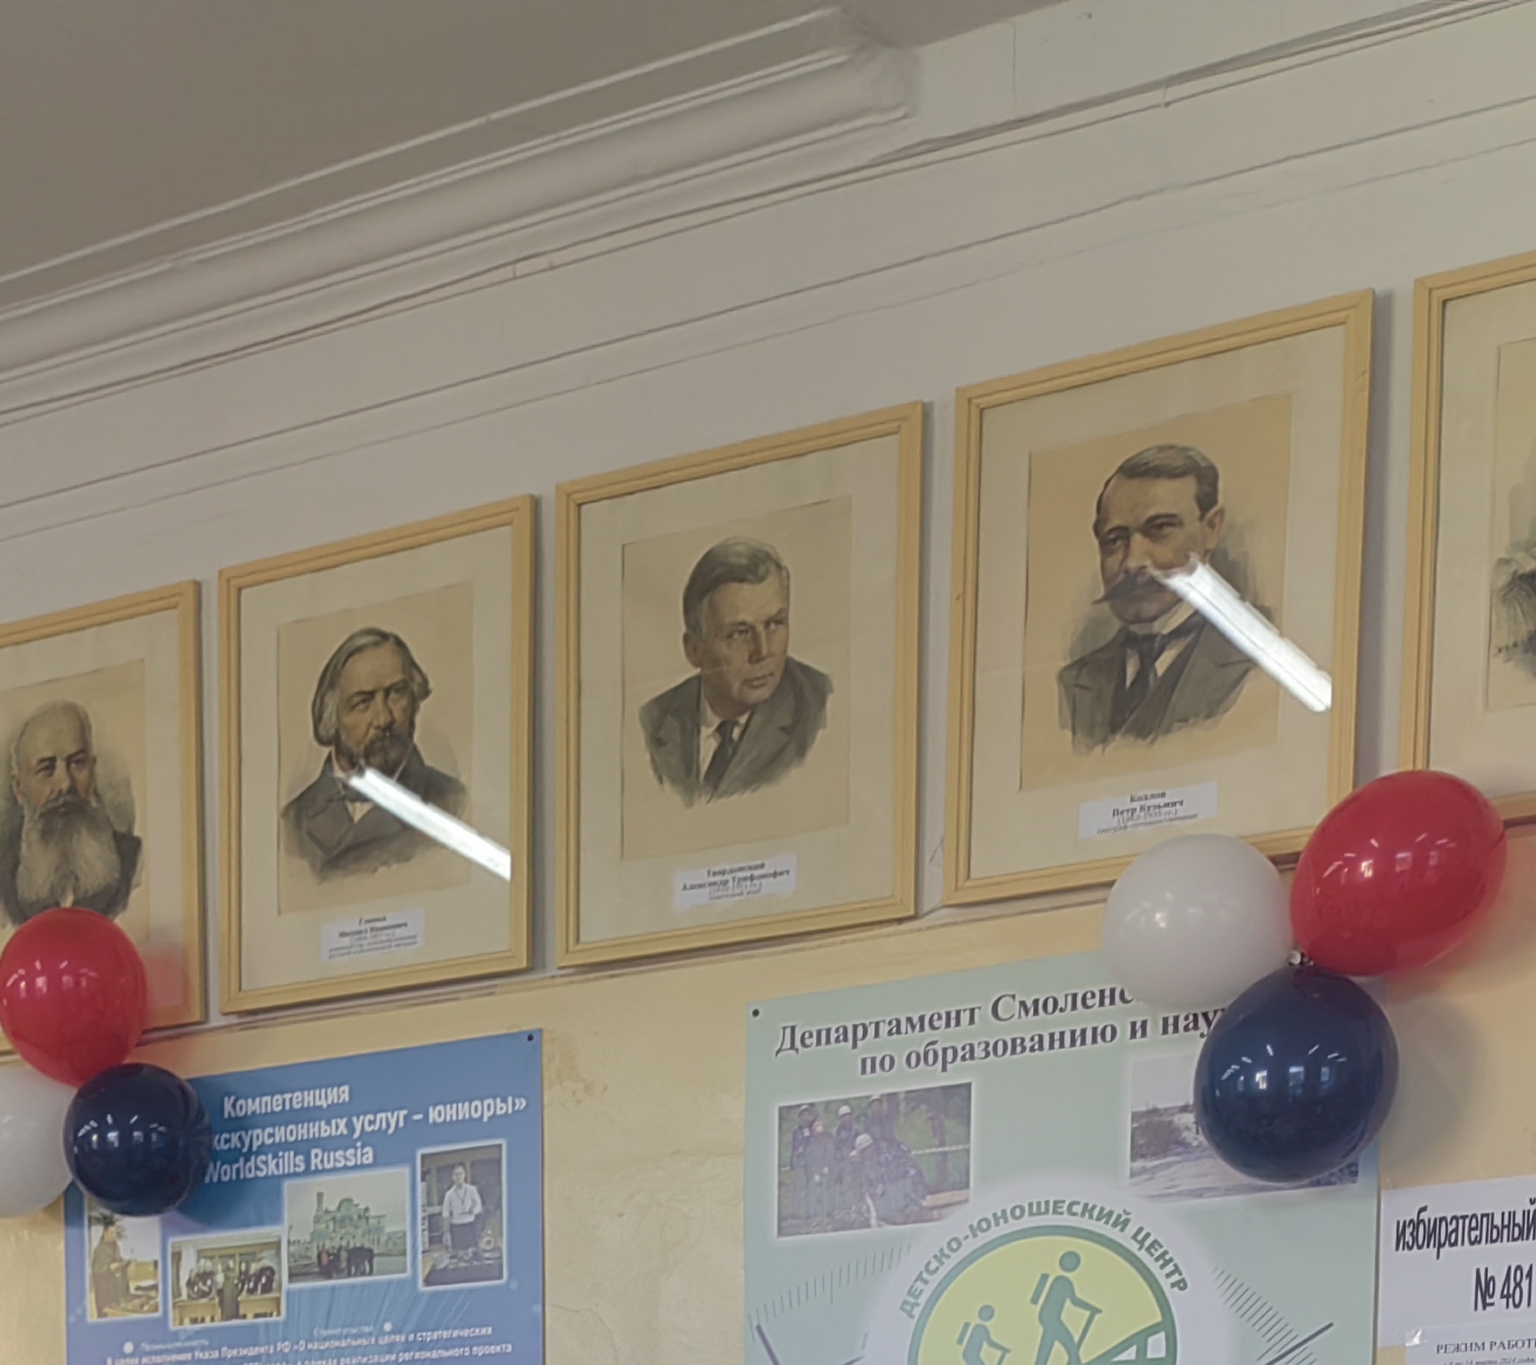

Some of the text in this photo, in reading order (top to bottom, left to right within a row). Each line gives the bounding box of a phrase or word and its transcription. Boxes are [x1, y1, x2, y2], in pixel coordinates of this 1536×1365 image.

[775, 986, 1135, 1058] Департамент Смоленс
[860, 1007, 1226, 1076] по образованию и нау
[213, 1115, 348, 1153] кскурсионных
[352, 1109, 408, 1139] услуг
[428, 1095, 527, 1124] юниоры»
[223, 1084, 350, 1119] Компетенция
[311, 1141, 374, 1171] Russia
[1395, 1197, 1536, 1260] избирательный
[899, 1199, 1188, 1319] ДЕТСКО-ЮНОШЕСКИЙ ЦЕНТР
[1474, 1263, 1533, 1311] № 481
[1436, 1338, 1536, 1354] РЕЖИМ РАБОТ
